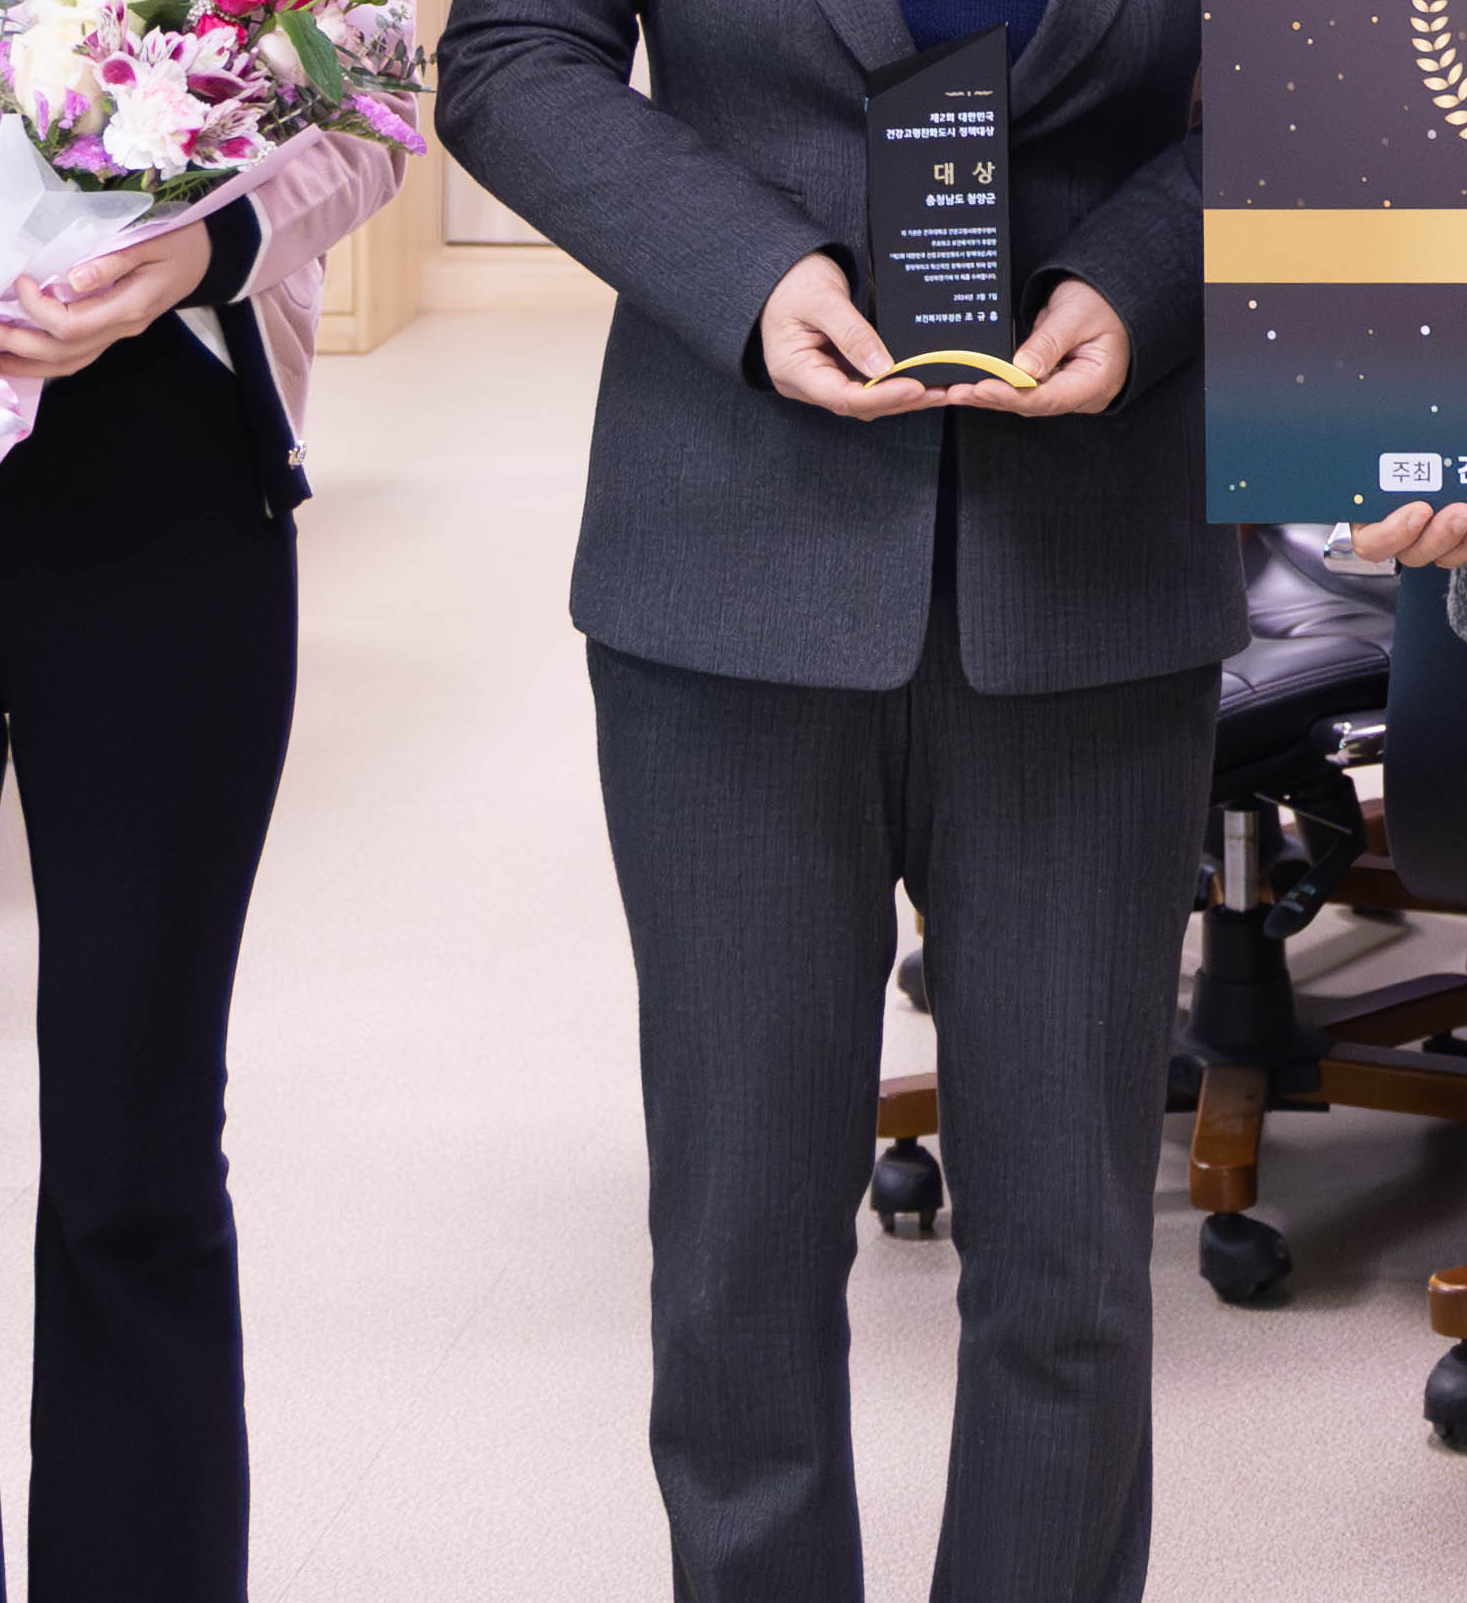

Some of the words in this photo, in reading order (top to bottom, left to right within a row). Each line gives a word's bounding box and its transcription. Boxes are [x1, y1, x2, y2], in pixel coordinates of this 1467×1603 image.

[930, 113, 955, 123] 제2회
[958, 111, 995, 123] 대한민국
[977, 311, 986, 322] 규
[1390, 459, 1434, 486] 주최
